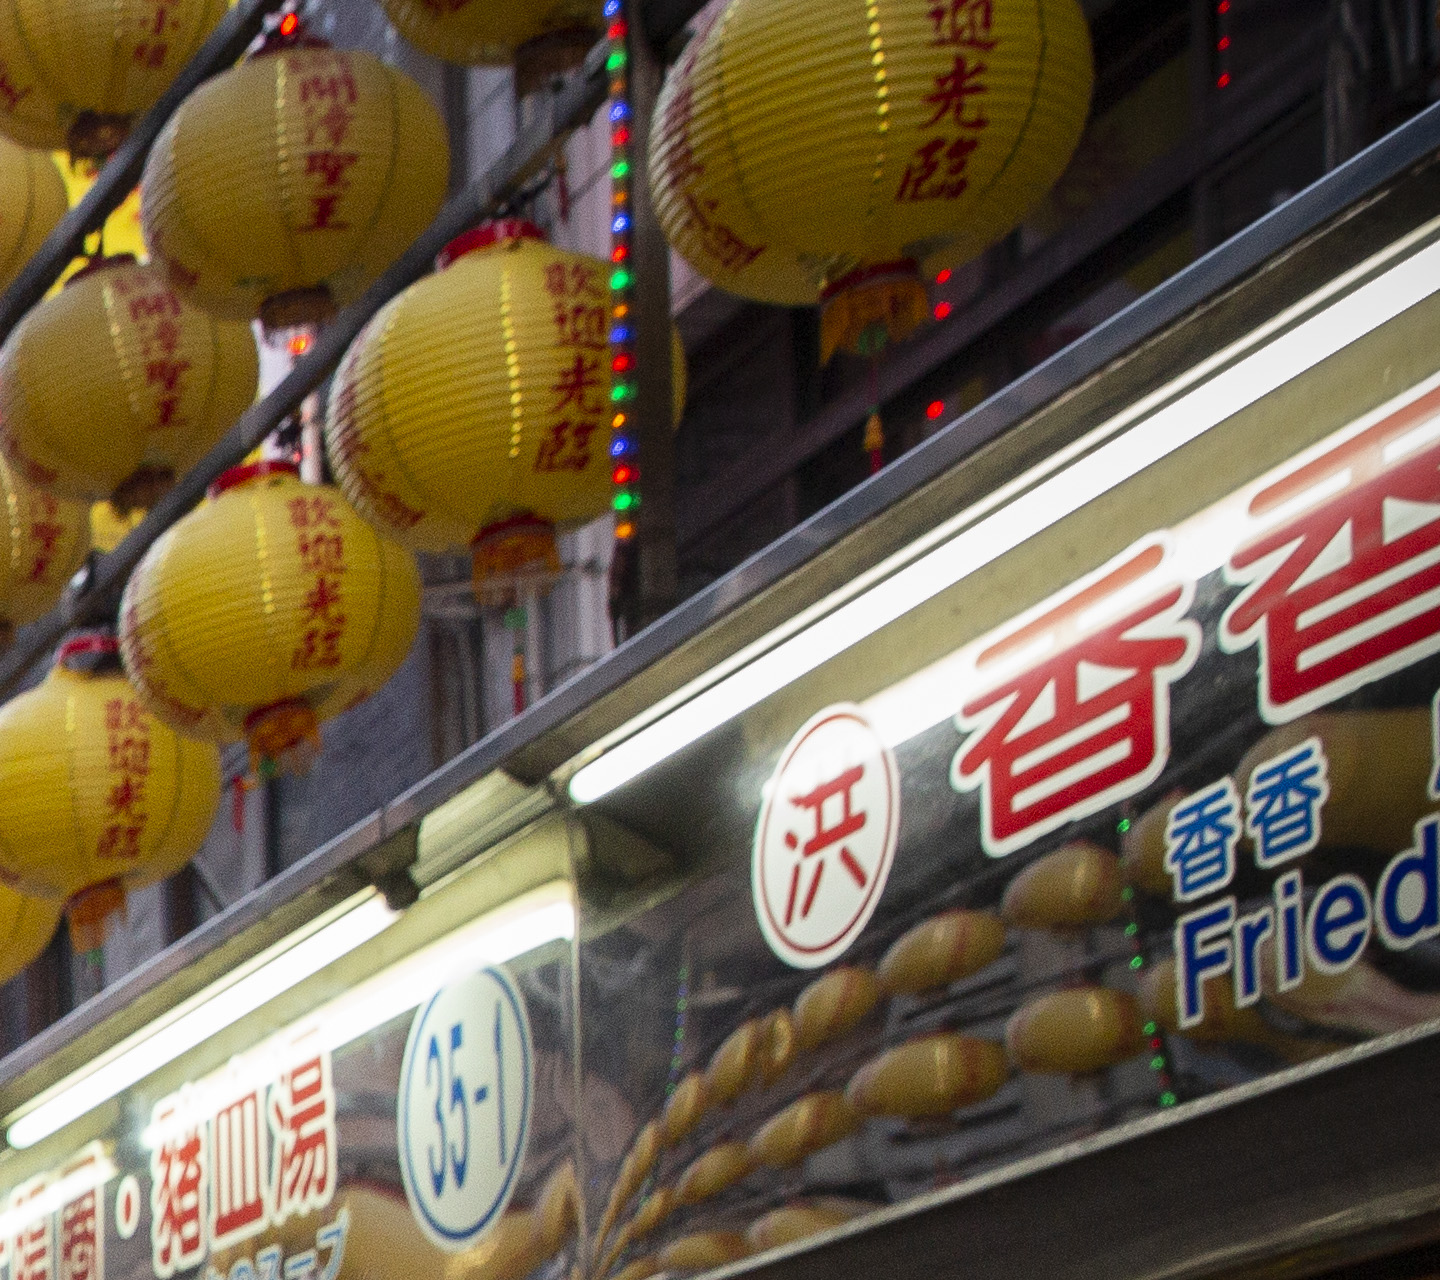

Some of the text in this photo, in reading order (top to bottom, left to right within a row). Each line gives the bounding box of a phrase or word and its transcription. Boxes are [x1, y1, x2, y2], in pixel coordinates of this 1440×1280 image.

[783, 765, 870, 927] 洪
[1170, 745, 1323, 897] 香香
[1181, 816, 1440, 1024] Fried
[425, 1000, 507, 1198] 35-1
